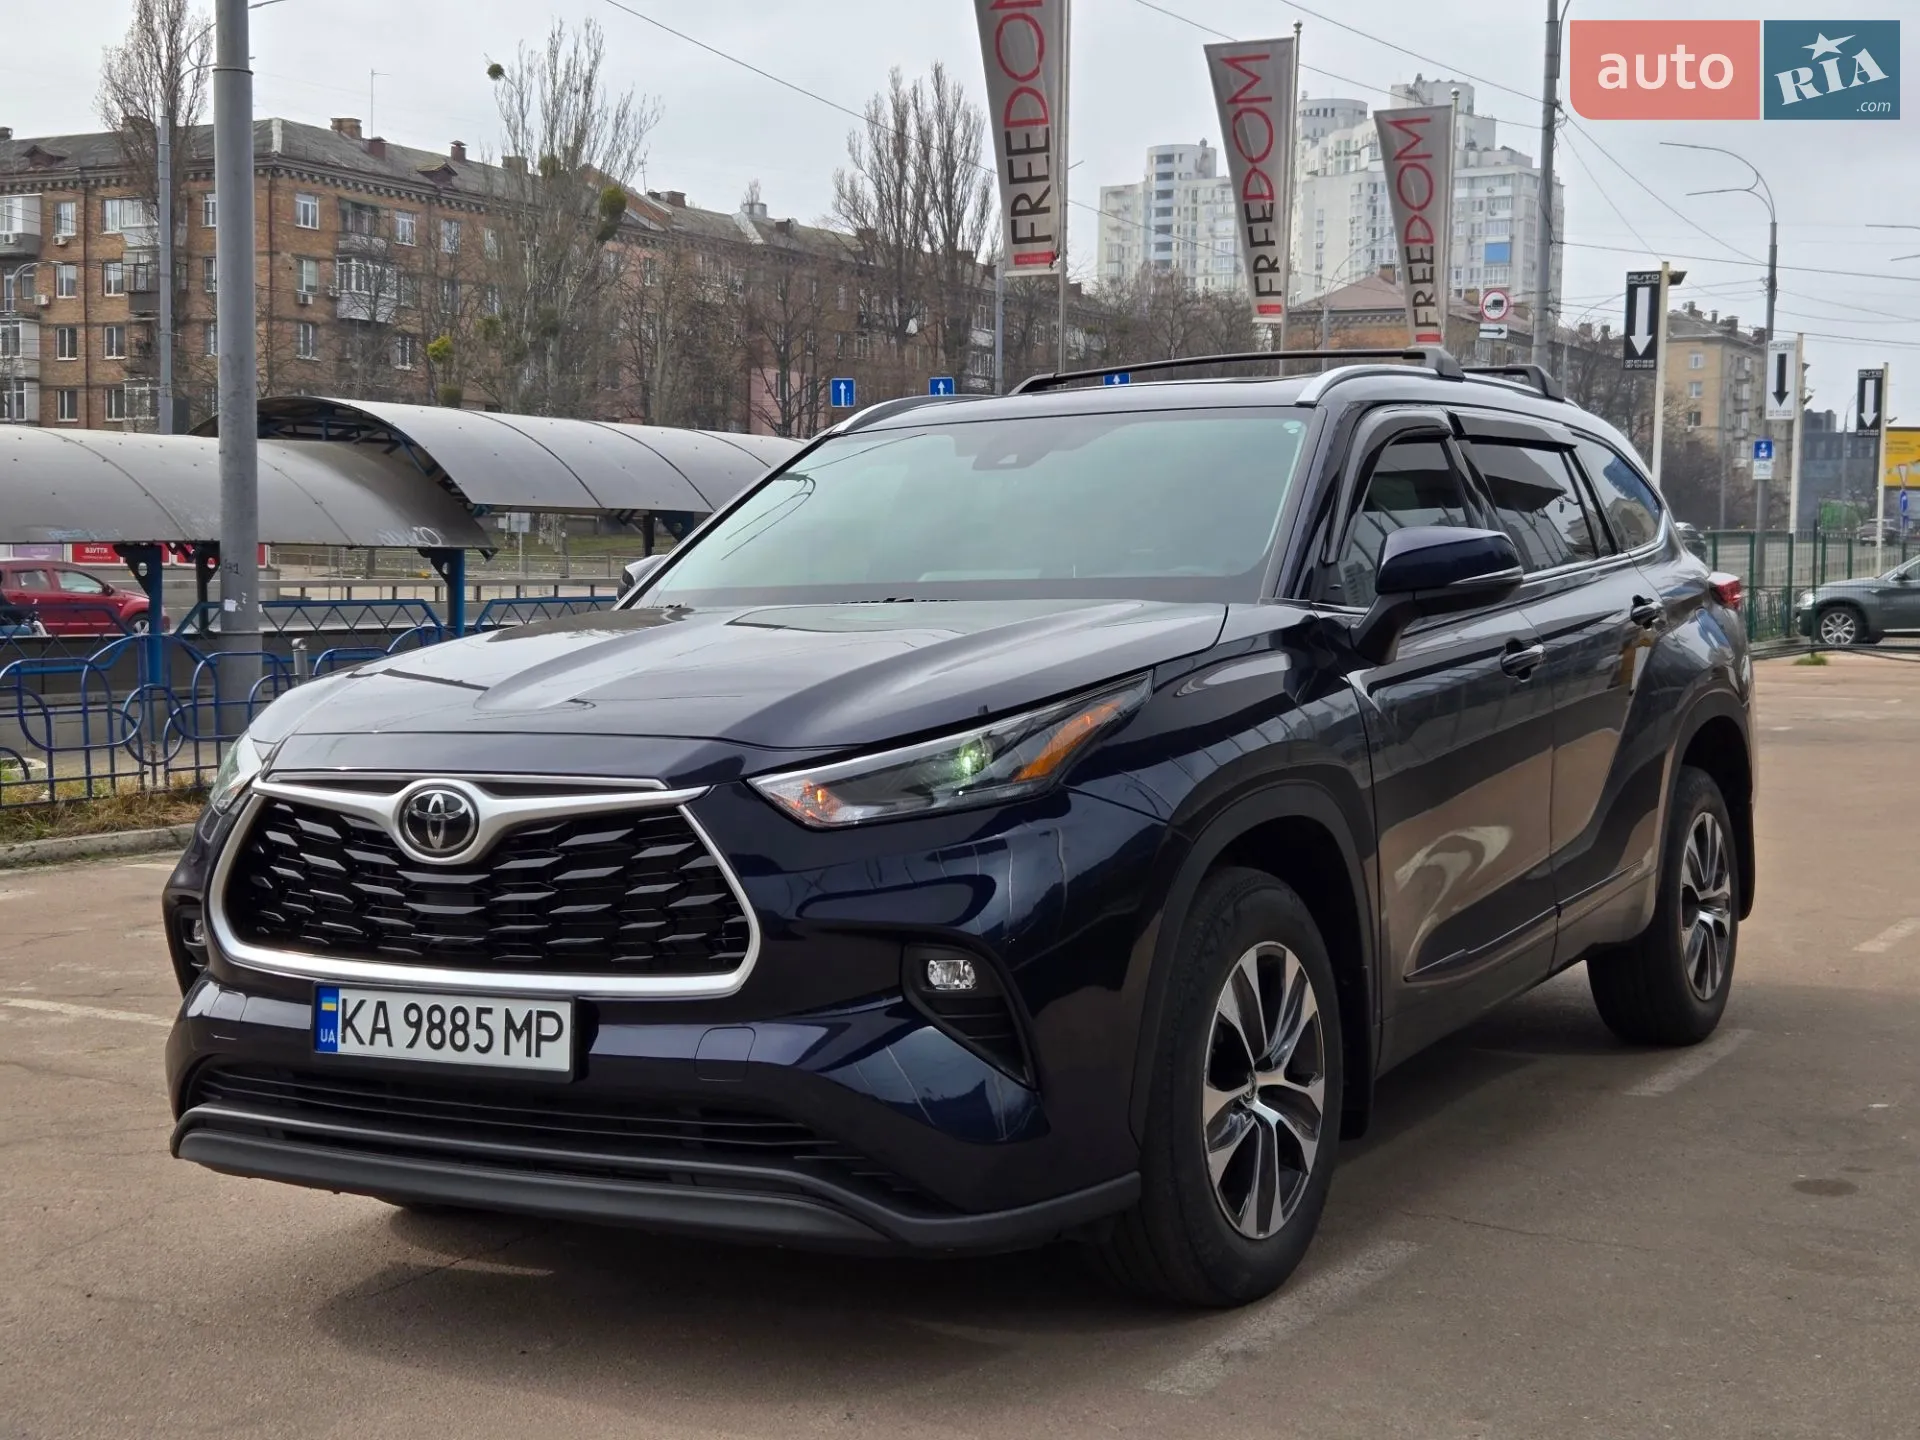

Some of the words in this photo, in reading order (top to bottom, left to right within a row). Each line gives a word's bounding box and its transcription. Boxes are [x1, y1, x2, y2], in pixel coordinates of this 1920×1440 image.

[988, 0, 1052, 245] FREEDO
[1386, 117, 1438, 328] FREEDOM
[320, 1028, 336, 1044] UA
[340, 997, 394, 1048] KA
[403, 1003, 495, 1054] 9885
[503, 1007, 564, 1058] MP
